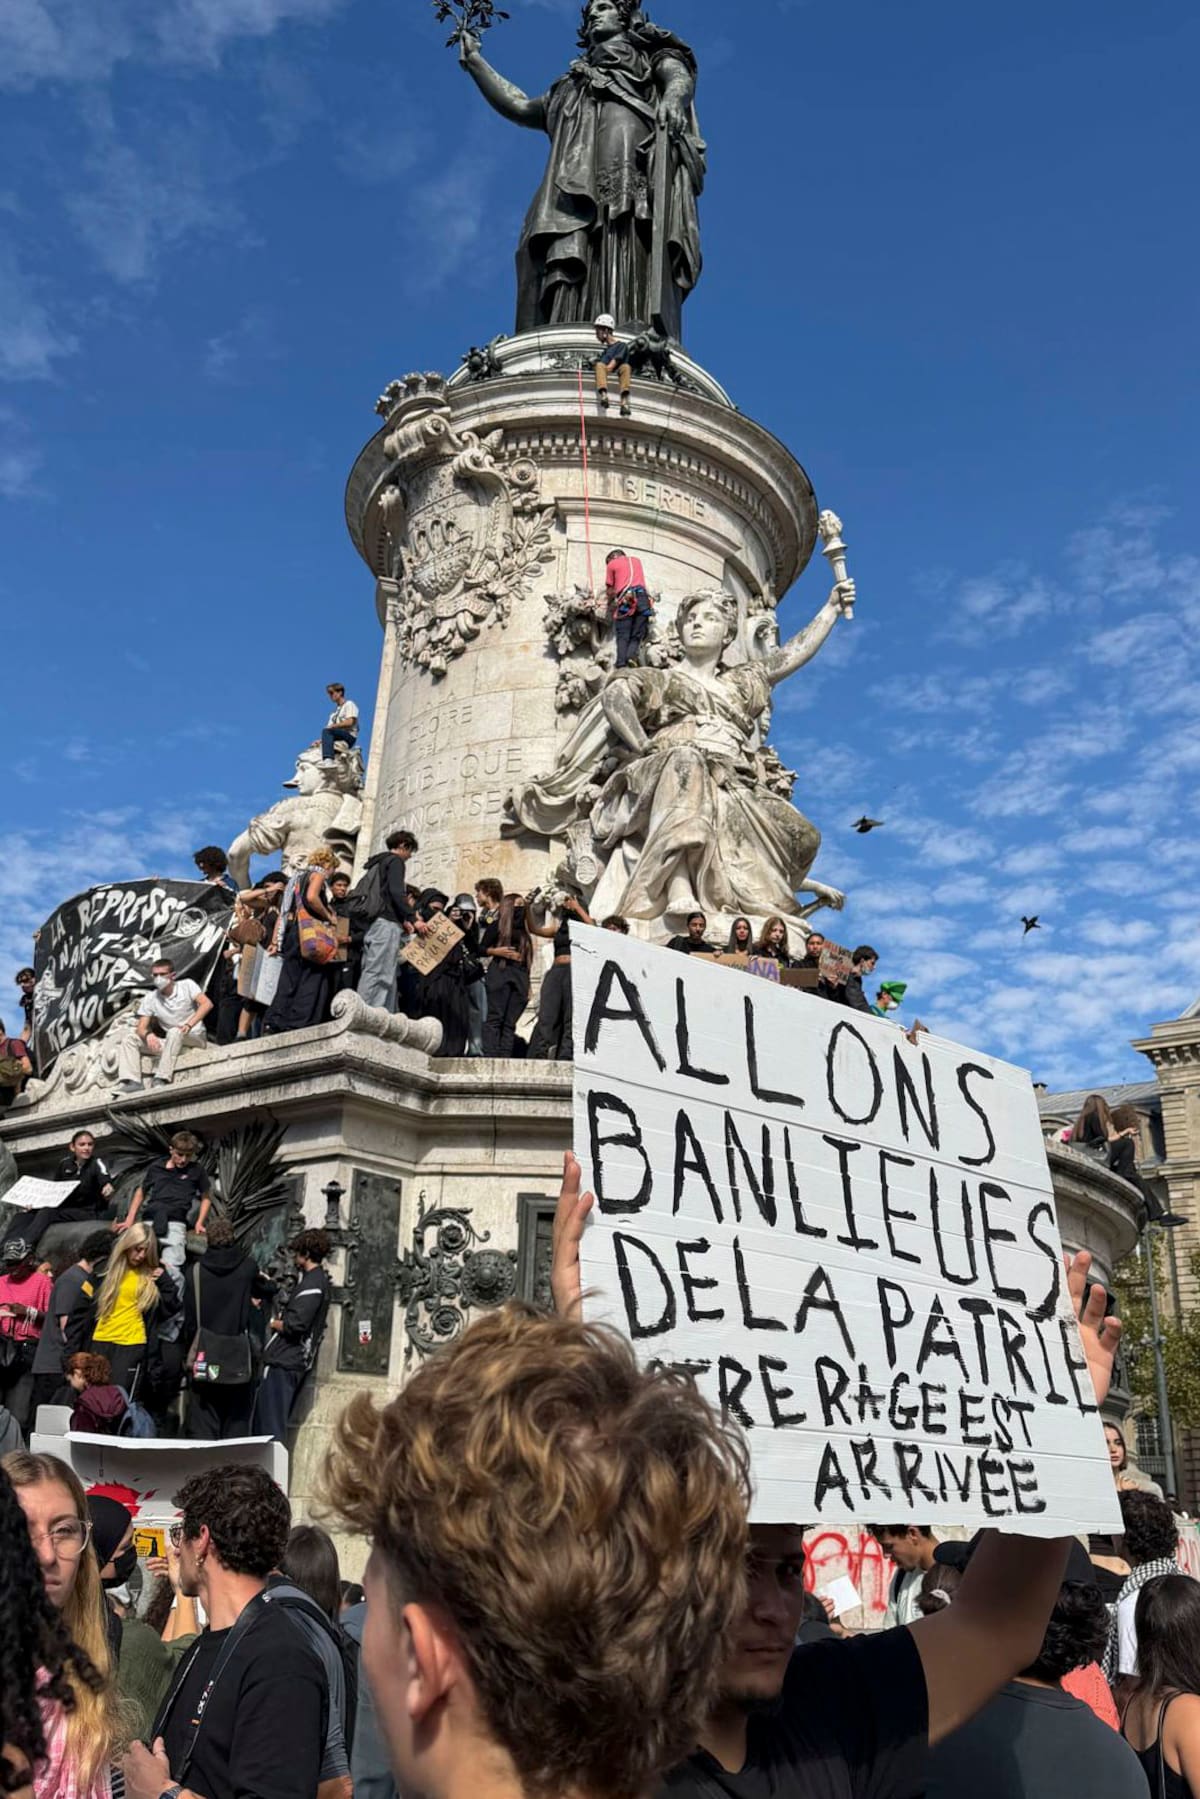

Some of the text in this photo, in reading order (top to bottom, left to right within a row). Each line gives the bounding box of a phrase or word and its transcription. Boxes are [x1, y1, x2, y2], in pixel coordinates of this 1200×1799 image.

[584, 960, 994, 1166] ALLONS
[587, 1089, 1060, 1322] BANLIEUES
[877, 1276, 1099, 1418] PATRIE
[959, 1388, 1036, 1455] EST
